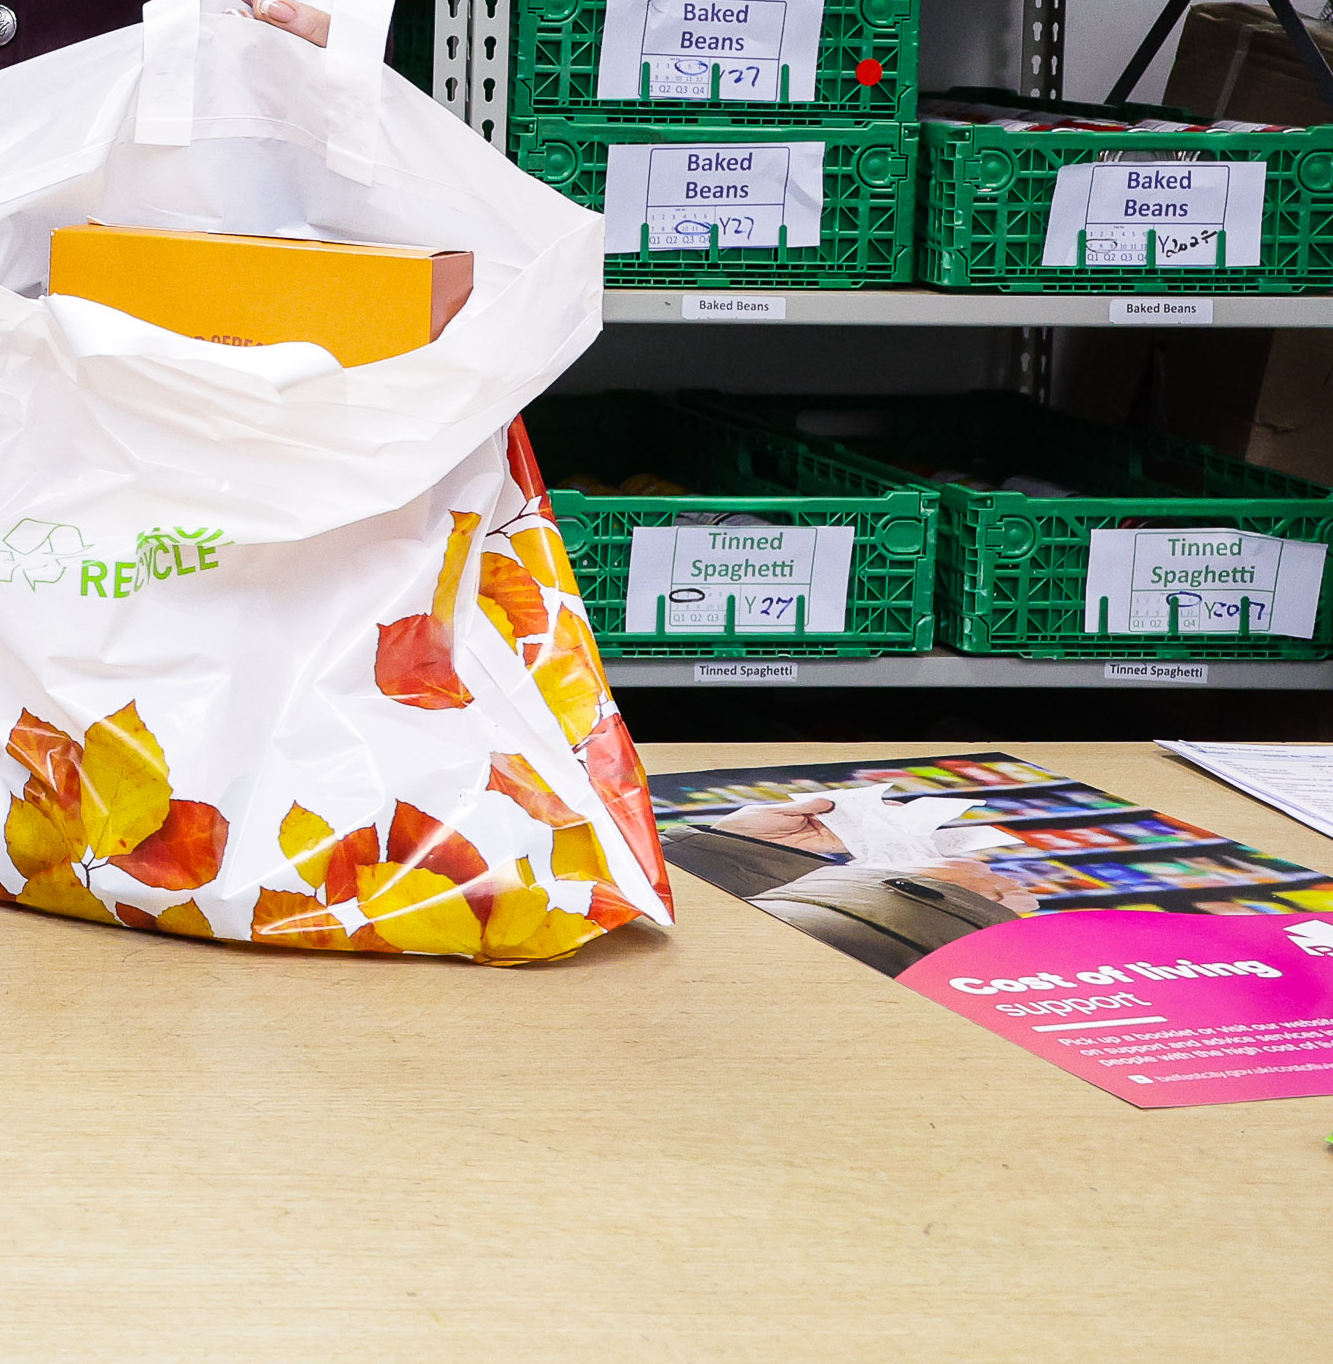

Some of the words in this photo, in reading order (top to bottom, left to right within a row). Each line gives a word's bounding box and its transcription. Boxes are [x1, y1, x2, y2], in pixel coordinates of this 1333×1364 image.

[684, 2, 749, 23] Baked
[681, 31, 744, 51] Beans
[688, 153, 752, 171] Baked
[1127, 171, 1191, 190] Baked
[685, 182, 749, 199] Beans
[1124, 199, 1189, 217] Beans
[699, 300, 733, 311] Baked
[736, 301, 769, 312] Beans
[1126, 304, 1161, 313] Baked
[1163, 304, 1196, 313] Beans
[709, 532, 783, 550] Tinned
[1168, 538, 1242, 556] Tinned
[81, 544, 218, 598] RECYCLE
[691, 559, 794, 581] Spaghetti
[1151, 566, 1255, 587] Spaghetti
[699, 666, 737, 676] Tinned
[740, 666, 792, 677] Spaghetti
[1110, 664, 1147, 675] Tinned
[1150, 666, 1203, 679] Spaghetti
[949, 972, 1078, 995] Cost
[1075, 965, 1134, 985] of
[1124, 960, 1282, 978] living
[995, 992, 1152, 1017] support
